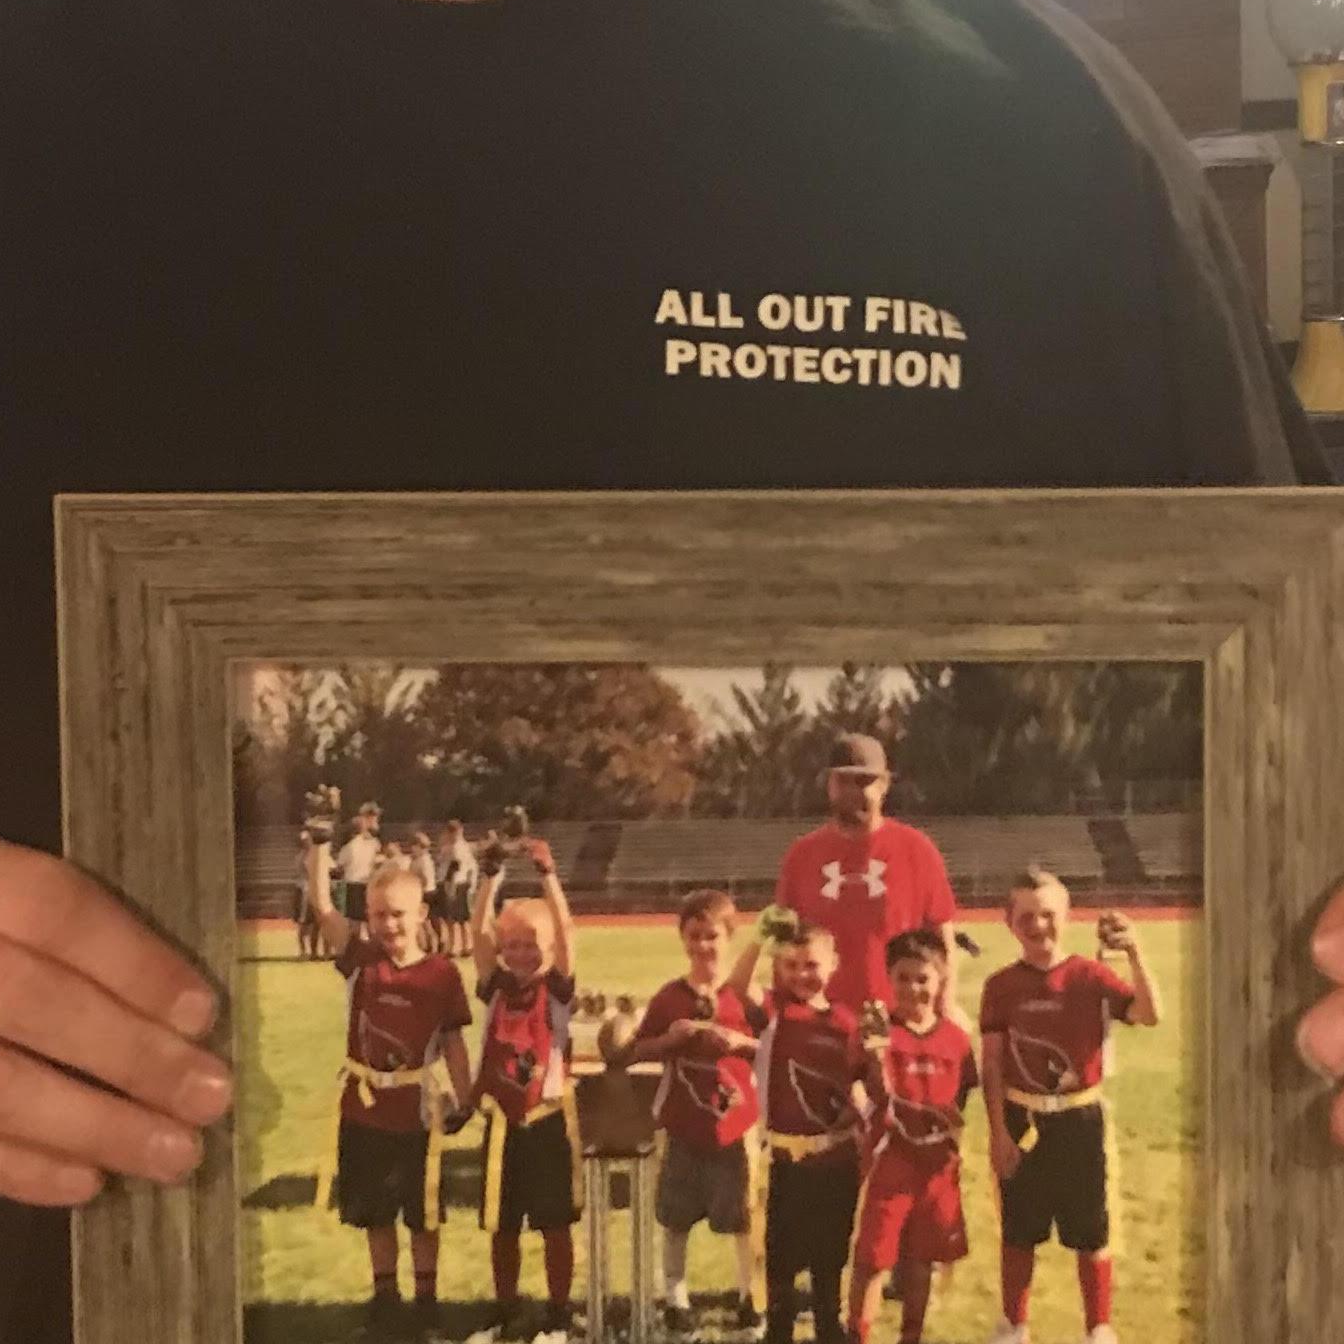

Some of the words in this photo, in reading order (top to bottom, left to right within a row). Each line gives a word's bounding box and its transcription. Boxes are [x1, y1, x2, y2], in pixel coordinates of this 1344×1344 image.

[654, 289, 744, 329] ALL
[757, 293, 851, 332] OUT
[864, 296, 968, 341] FIRE
[665, 339, 961, 390] PROTECTION
